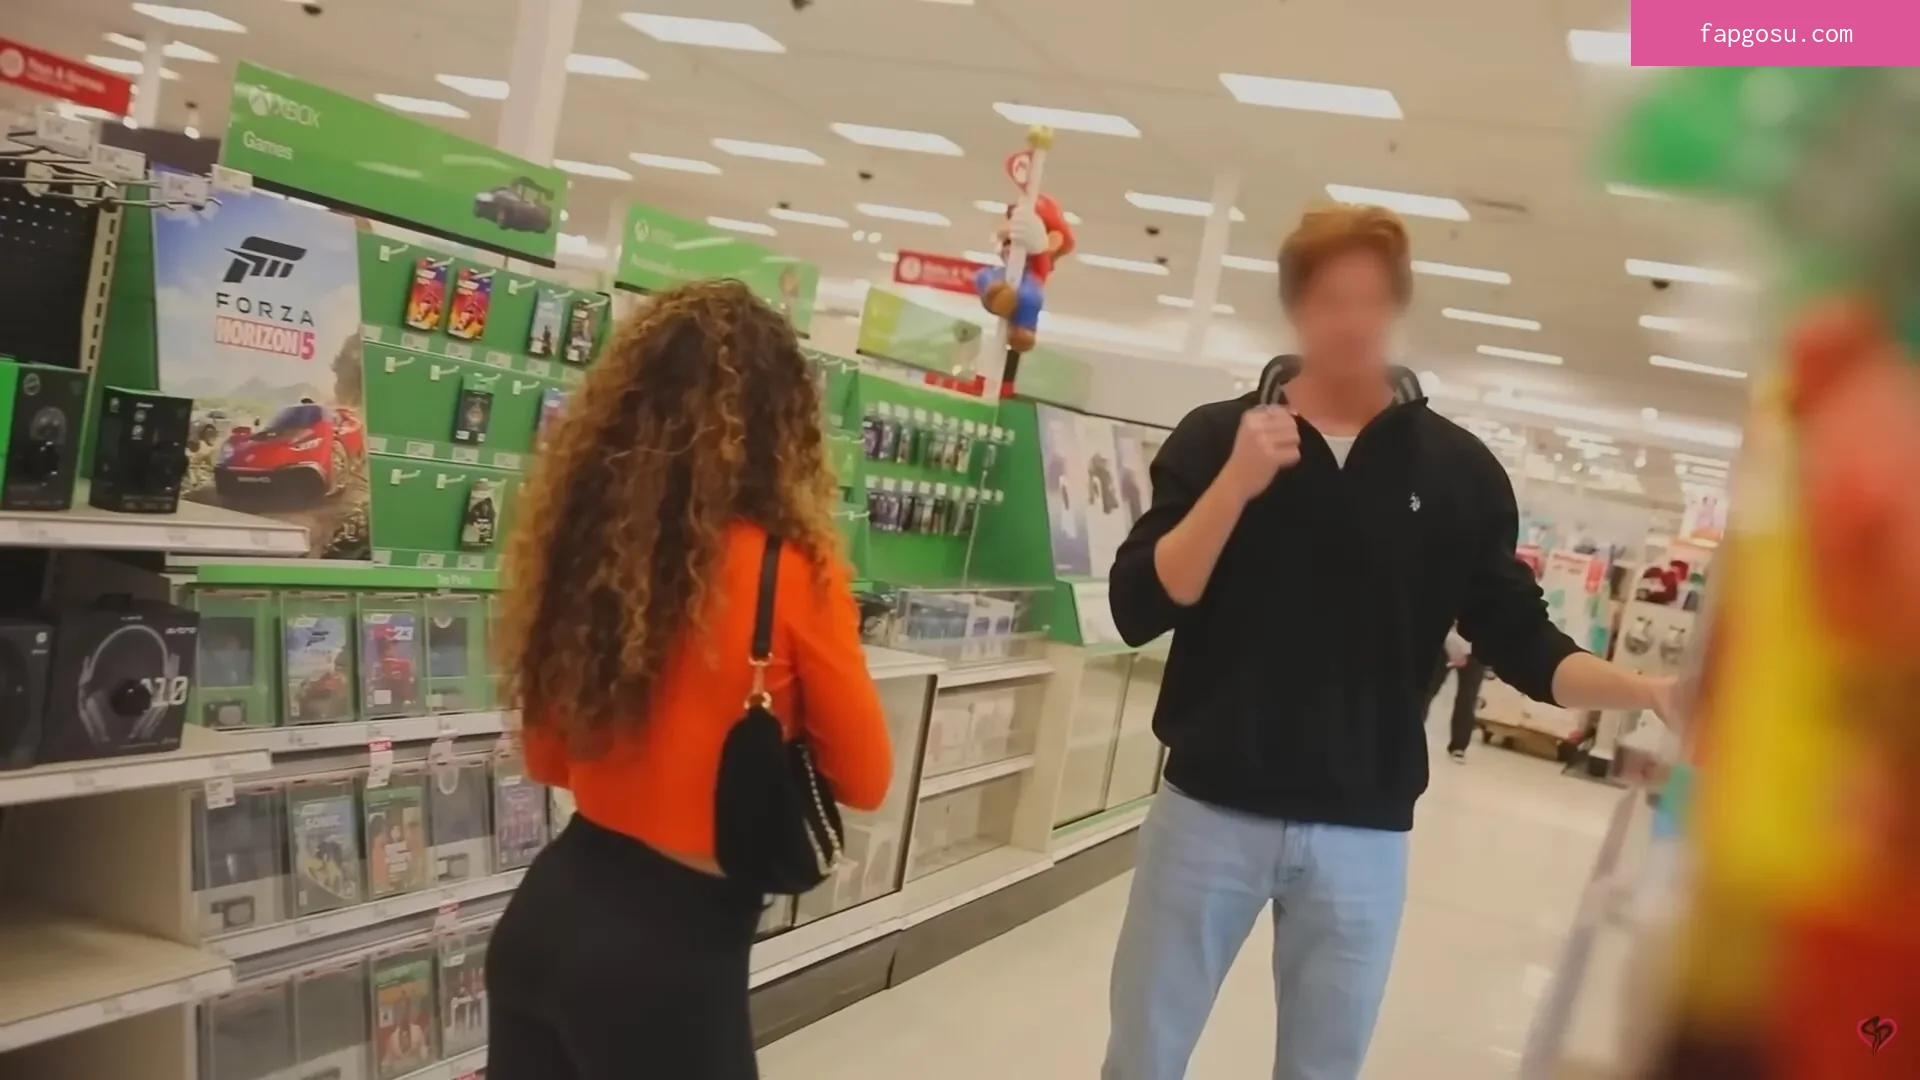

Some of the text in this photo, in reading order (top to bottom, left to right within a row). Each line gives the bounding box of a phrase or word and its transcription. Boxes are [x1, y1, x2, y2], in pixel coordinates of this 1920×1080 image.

[271, 93, 323, 128] XBOX
[243, 130, 294, 161] Games
[216, 291, 315, 328] FORZA
[215, 316, 316, 361] HORIZON 5
